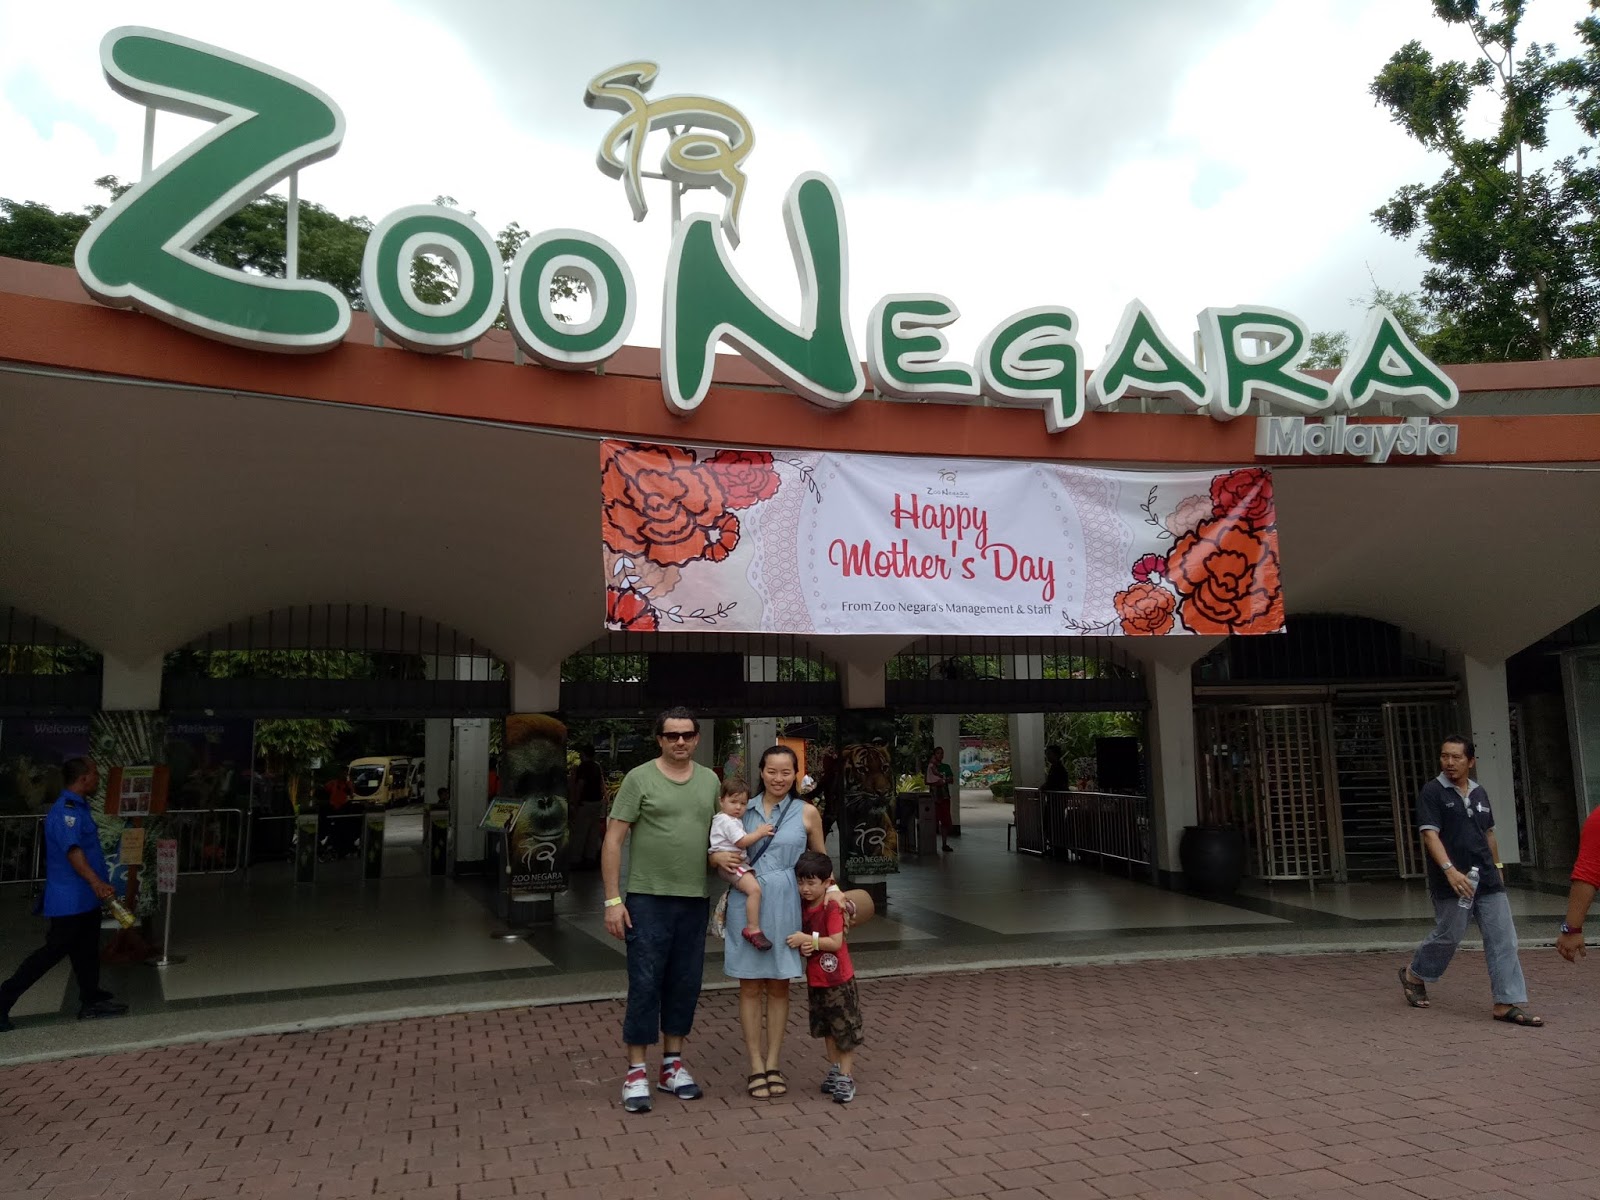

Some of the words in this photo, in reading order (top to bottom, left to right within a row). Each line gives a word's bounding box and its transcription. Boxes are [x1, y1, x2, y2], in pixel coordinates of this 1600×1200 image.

[1257, 415, 1459, 464] Malaysia
[890, 492, 989, 550] Happy
[828, 538, 976, 580] Mother's
[980, 542, 1056, 603] Day
[841, 600, 872, 612] From
[874, 601, 896, 612] Zoo
[898, 602, 944, 615] Negara's
[945, 602, 1014, 617] Management
[1016, 604, 1024, 614] &
[1027, 603, 1053, 615] Staff
[34, 723, 89, 735] Welcome
[512, 874, 530, 883] ZOO
[531, 872, 563, 881] NEGARA
